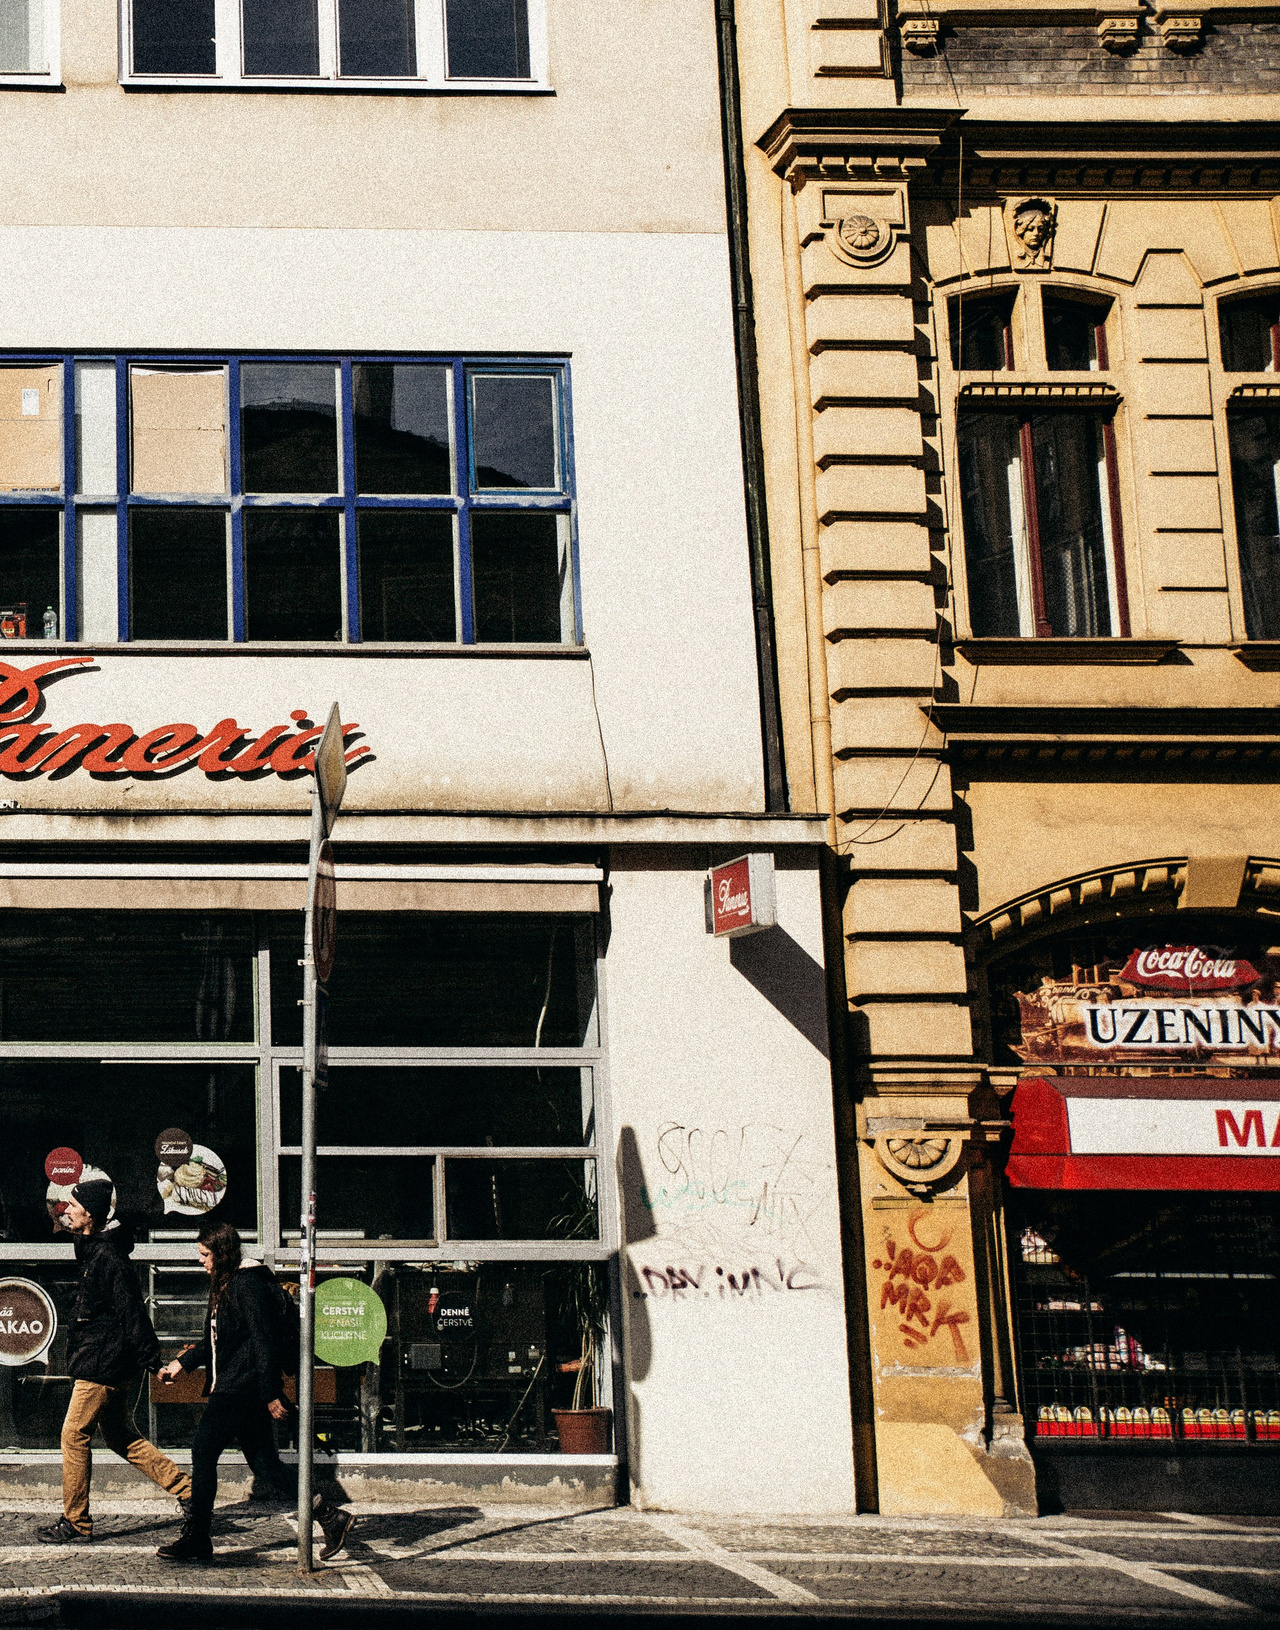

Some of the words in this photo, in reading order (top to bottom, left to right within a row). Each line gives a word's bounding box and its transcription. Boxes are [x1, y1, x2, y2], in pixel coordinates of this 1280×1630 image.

[1136, 947, 1237, 979] Coca-Cola
[1214, 1109, 1280, 1148] M
[329, 1319, 334, 1328] Z
